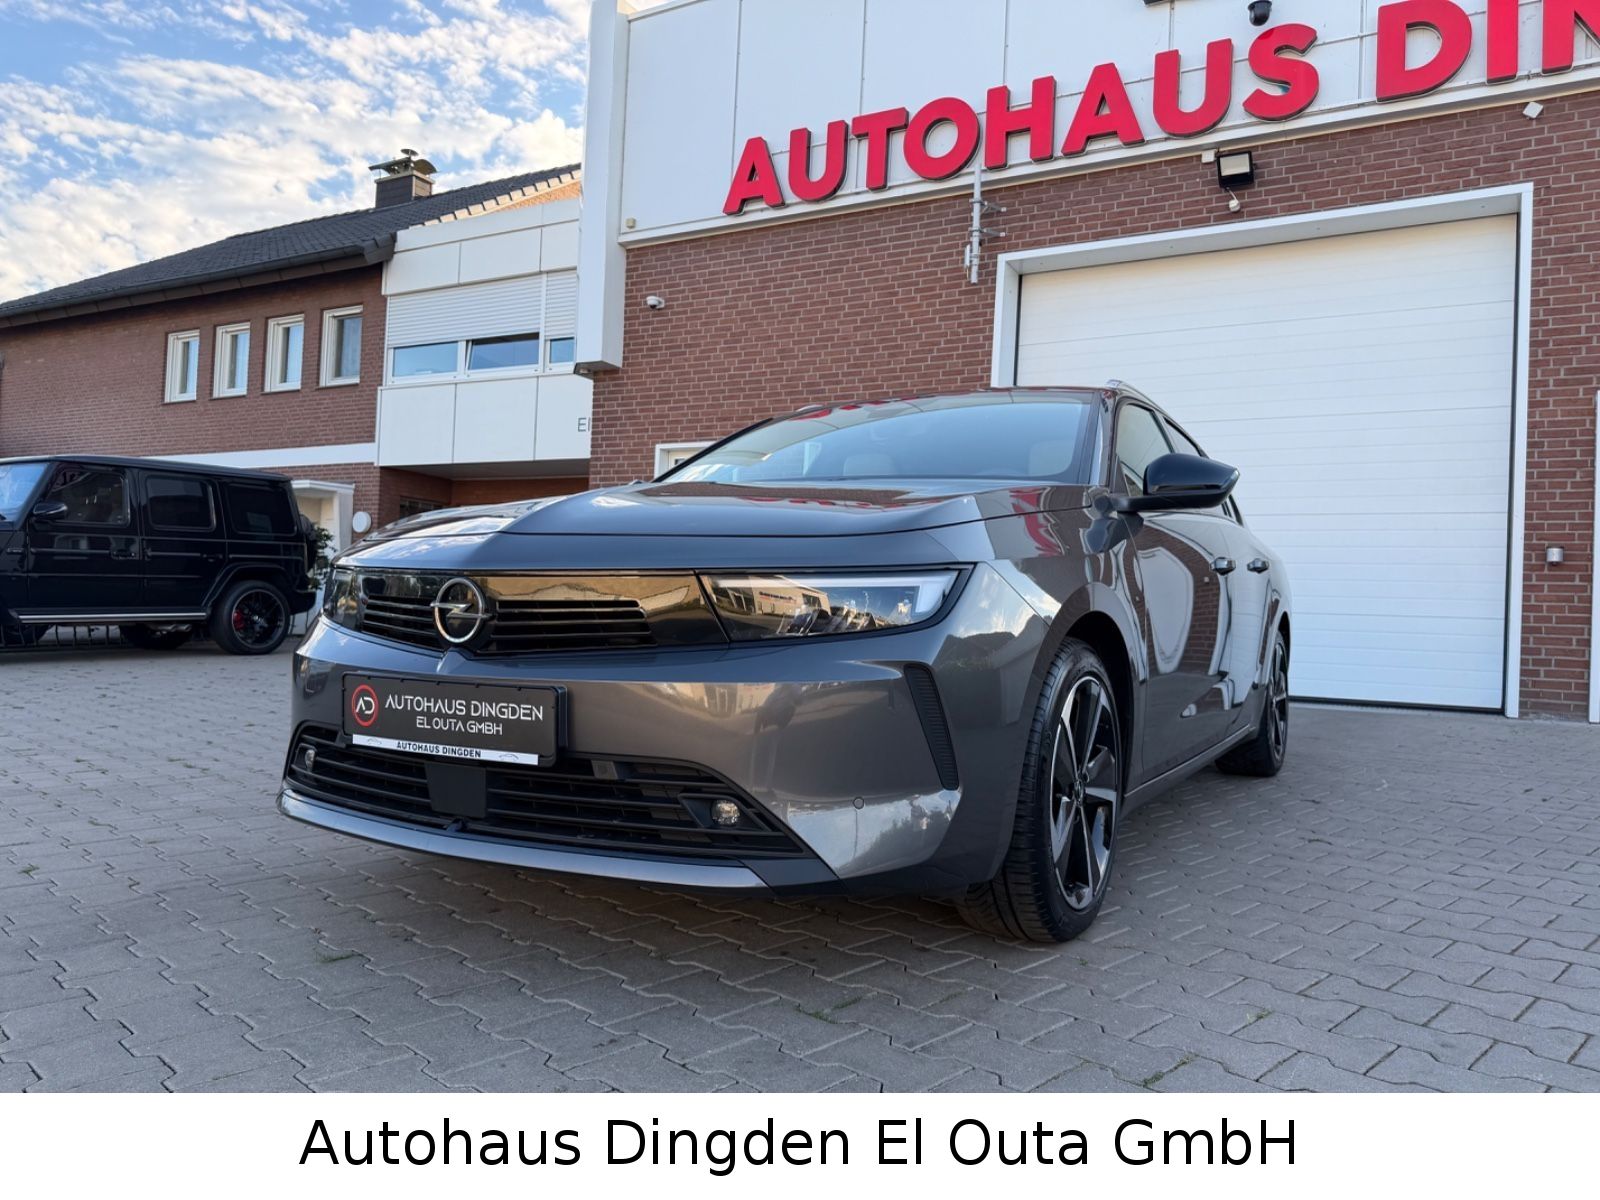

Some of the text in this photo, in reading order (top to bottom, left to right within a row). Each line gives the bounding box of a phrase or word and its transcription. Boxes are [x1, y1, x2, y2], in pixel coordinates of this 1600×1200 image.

[723, 25, 1319, 214] AUTOHAUS
[385, 694, 543, 720] AUTOHAUS DINGDEN
[416, 716, 502, 735] EL OUTA GMBH
[396, 741, 481, 758] AUTOHAUS DINGDEN
